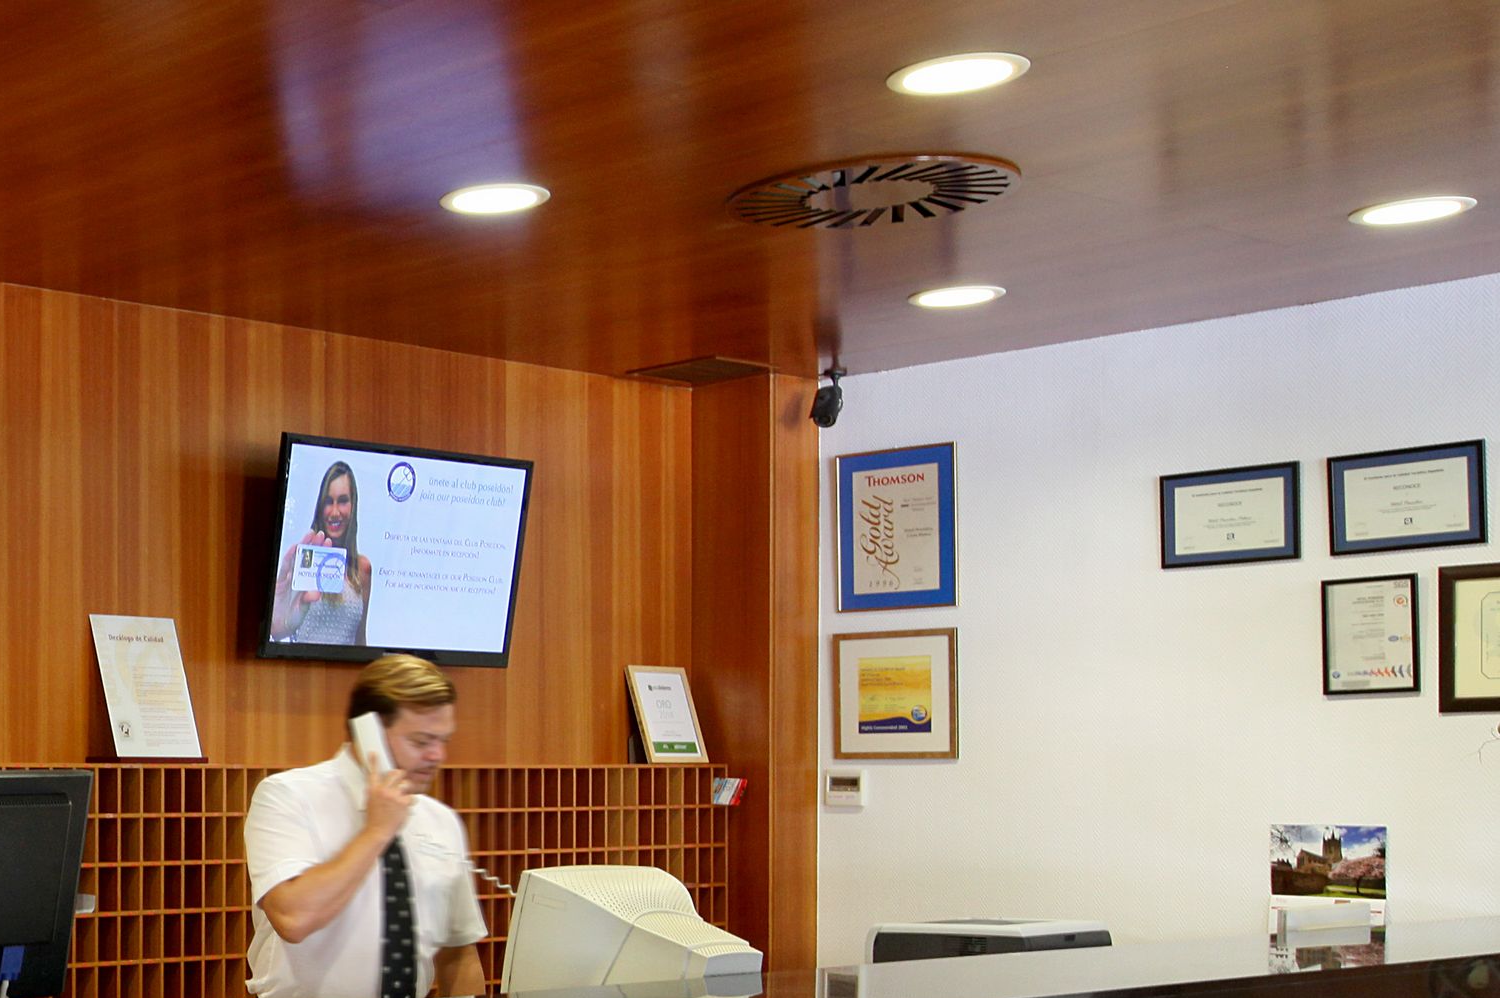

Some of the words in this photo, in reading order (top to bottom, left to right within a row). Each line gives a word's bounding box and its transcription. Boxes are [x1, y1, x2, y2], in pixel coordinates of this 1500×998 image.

[460, 479, 477, 490] club
[865, 473, 925, 487] THOMSON
[858, 499, 882, 555] Gold
[867, 495, 900, 588] Award
